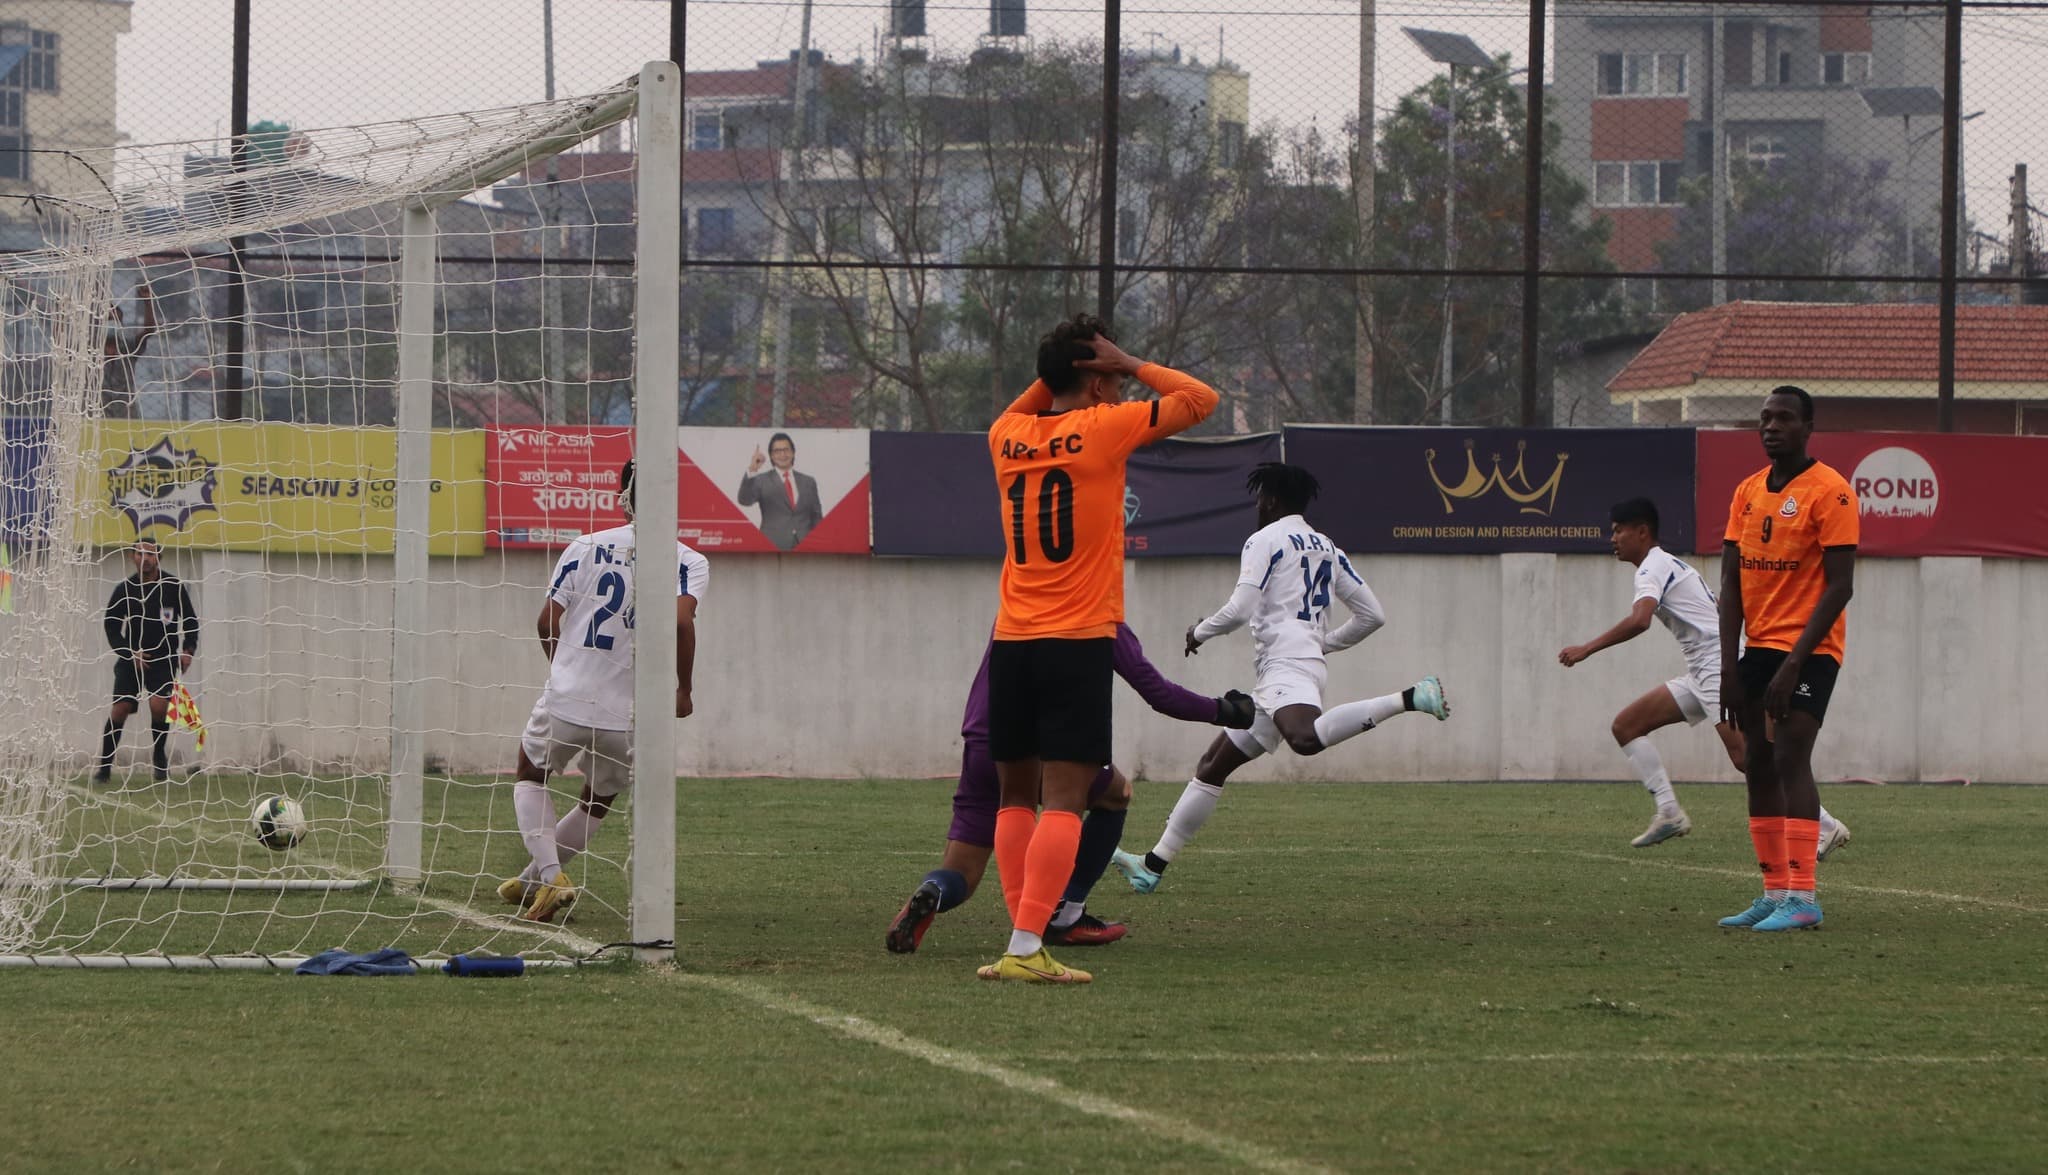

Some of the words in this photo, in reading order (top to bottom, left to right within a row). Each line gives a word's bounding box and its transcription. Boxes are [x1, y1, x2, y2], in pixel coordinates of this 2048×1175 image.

[528, 433, 553, 446] NIC
[558, 434, 595, 447] ASIA
[1049, 434, 1083, 458] FC
[240, 476, 340, 498] SEASON
[346, 478, 360, 498] 3
[1855, 477, 1935, 499] RONB
[1007, 468, 1074, 565] 10
[1393, 526, 1432, 538] CROWN
[1435, 526, 1474, 538] DESIGN
[1477, 526, 1499, 538] AND
[1502, 526, 1558, 538] RESEARCH
[1560, 526, 1600, 538] CENTER
[1760, 515, 1773, 543] 9
[1296, 555, 1332, 624] 14
